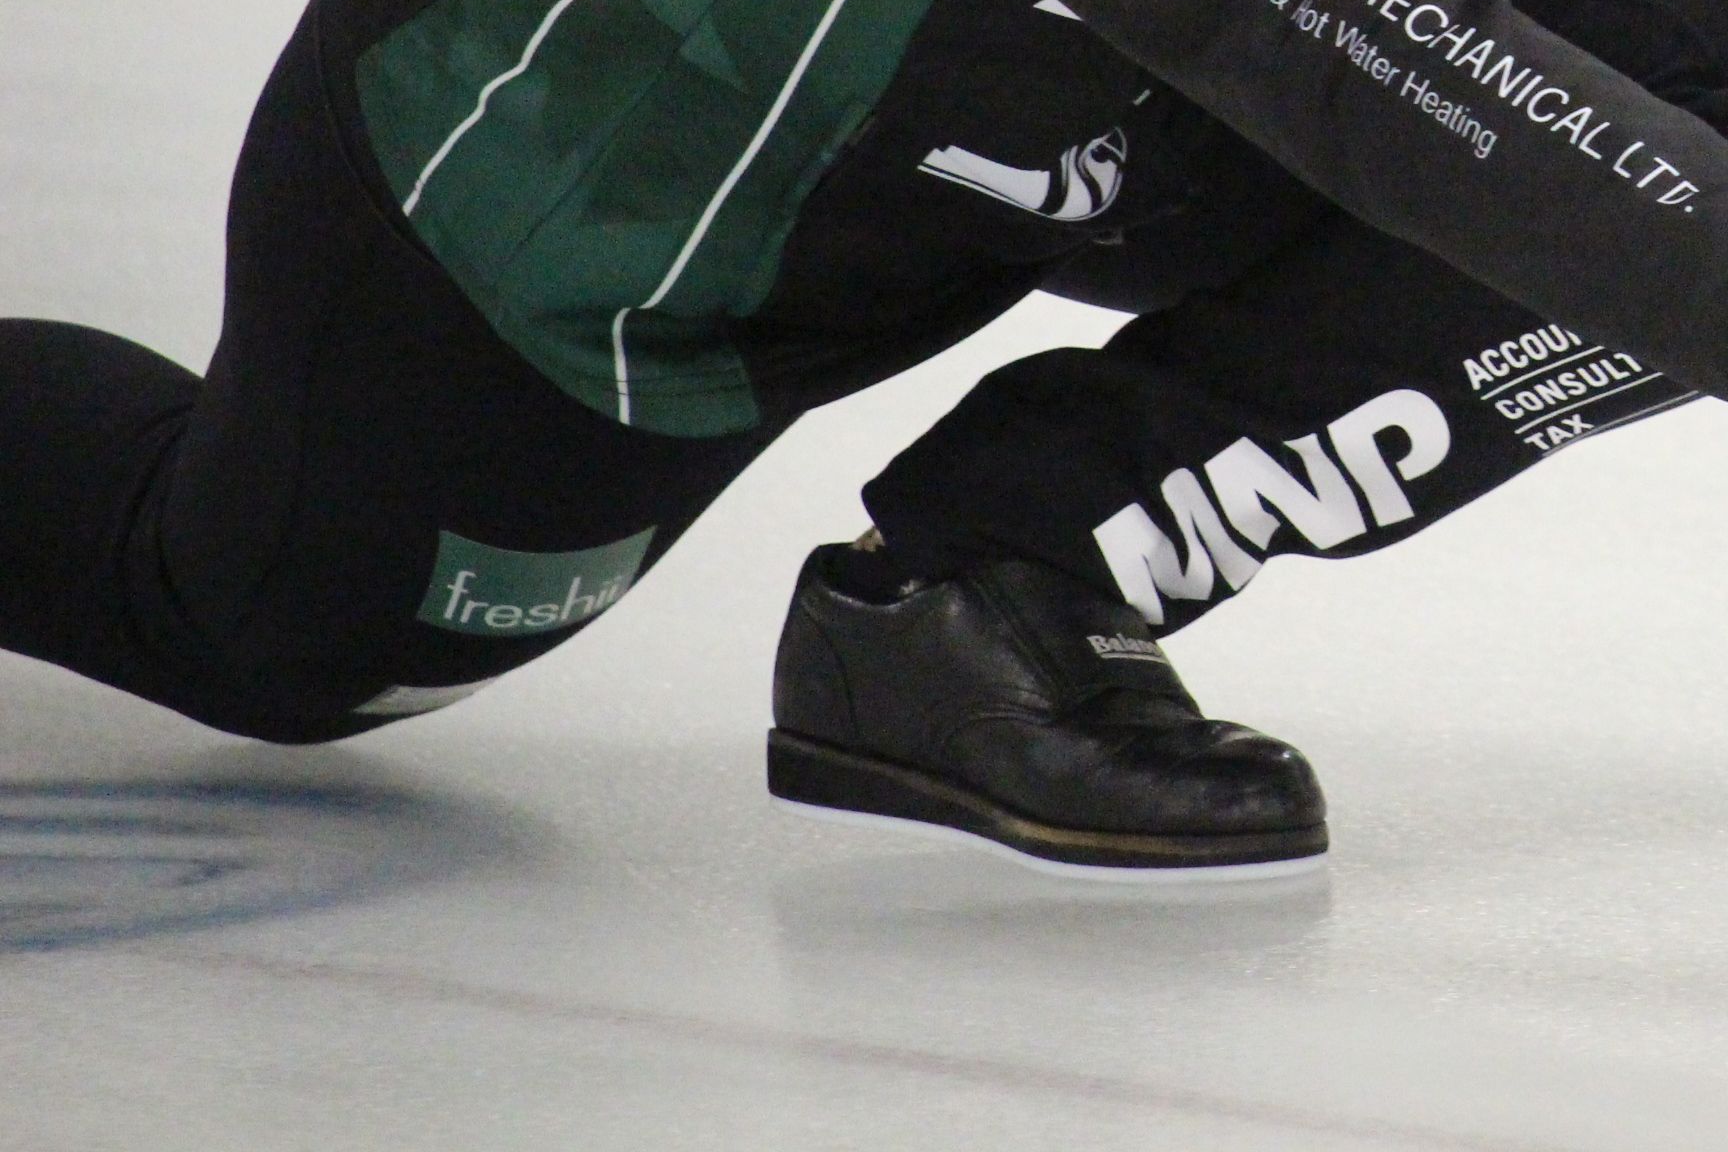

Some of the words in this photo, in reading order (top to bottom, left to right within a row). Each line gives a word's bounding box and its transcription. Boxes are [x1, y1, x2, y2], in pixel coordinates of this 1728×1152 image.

[1336, 19, 1403, 87] Water
[1400, 68, 1498, 159] Heating
[1614, 142, 1699, 213] LTD.
[1524, 414, 1594, 450] TAX
[1092, 389, 1450, 625] MNP
[443, 570, 622, 628] freshii
